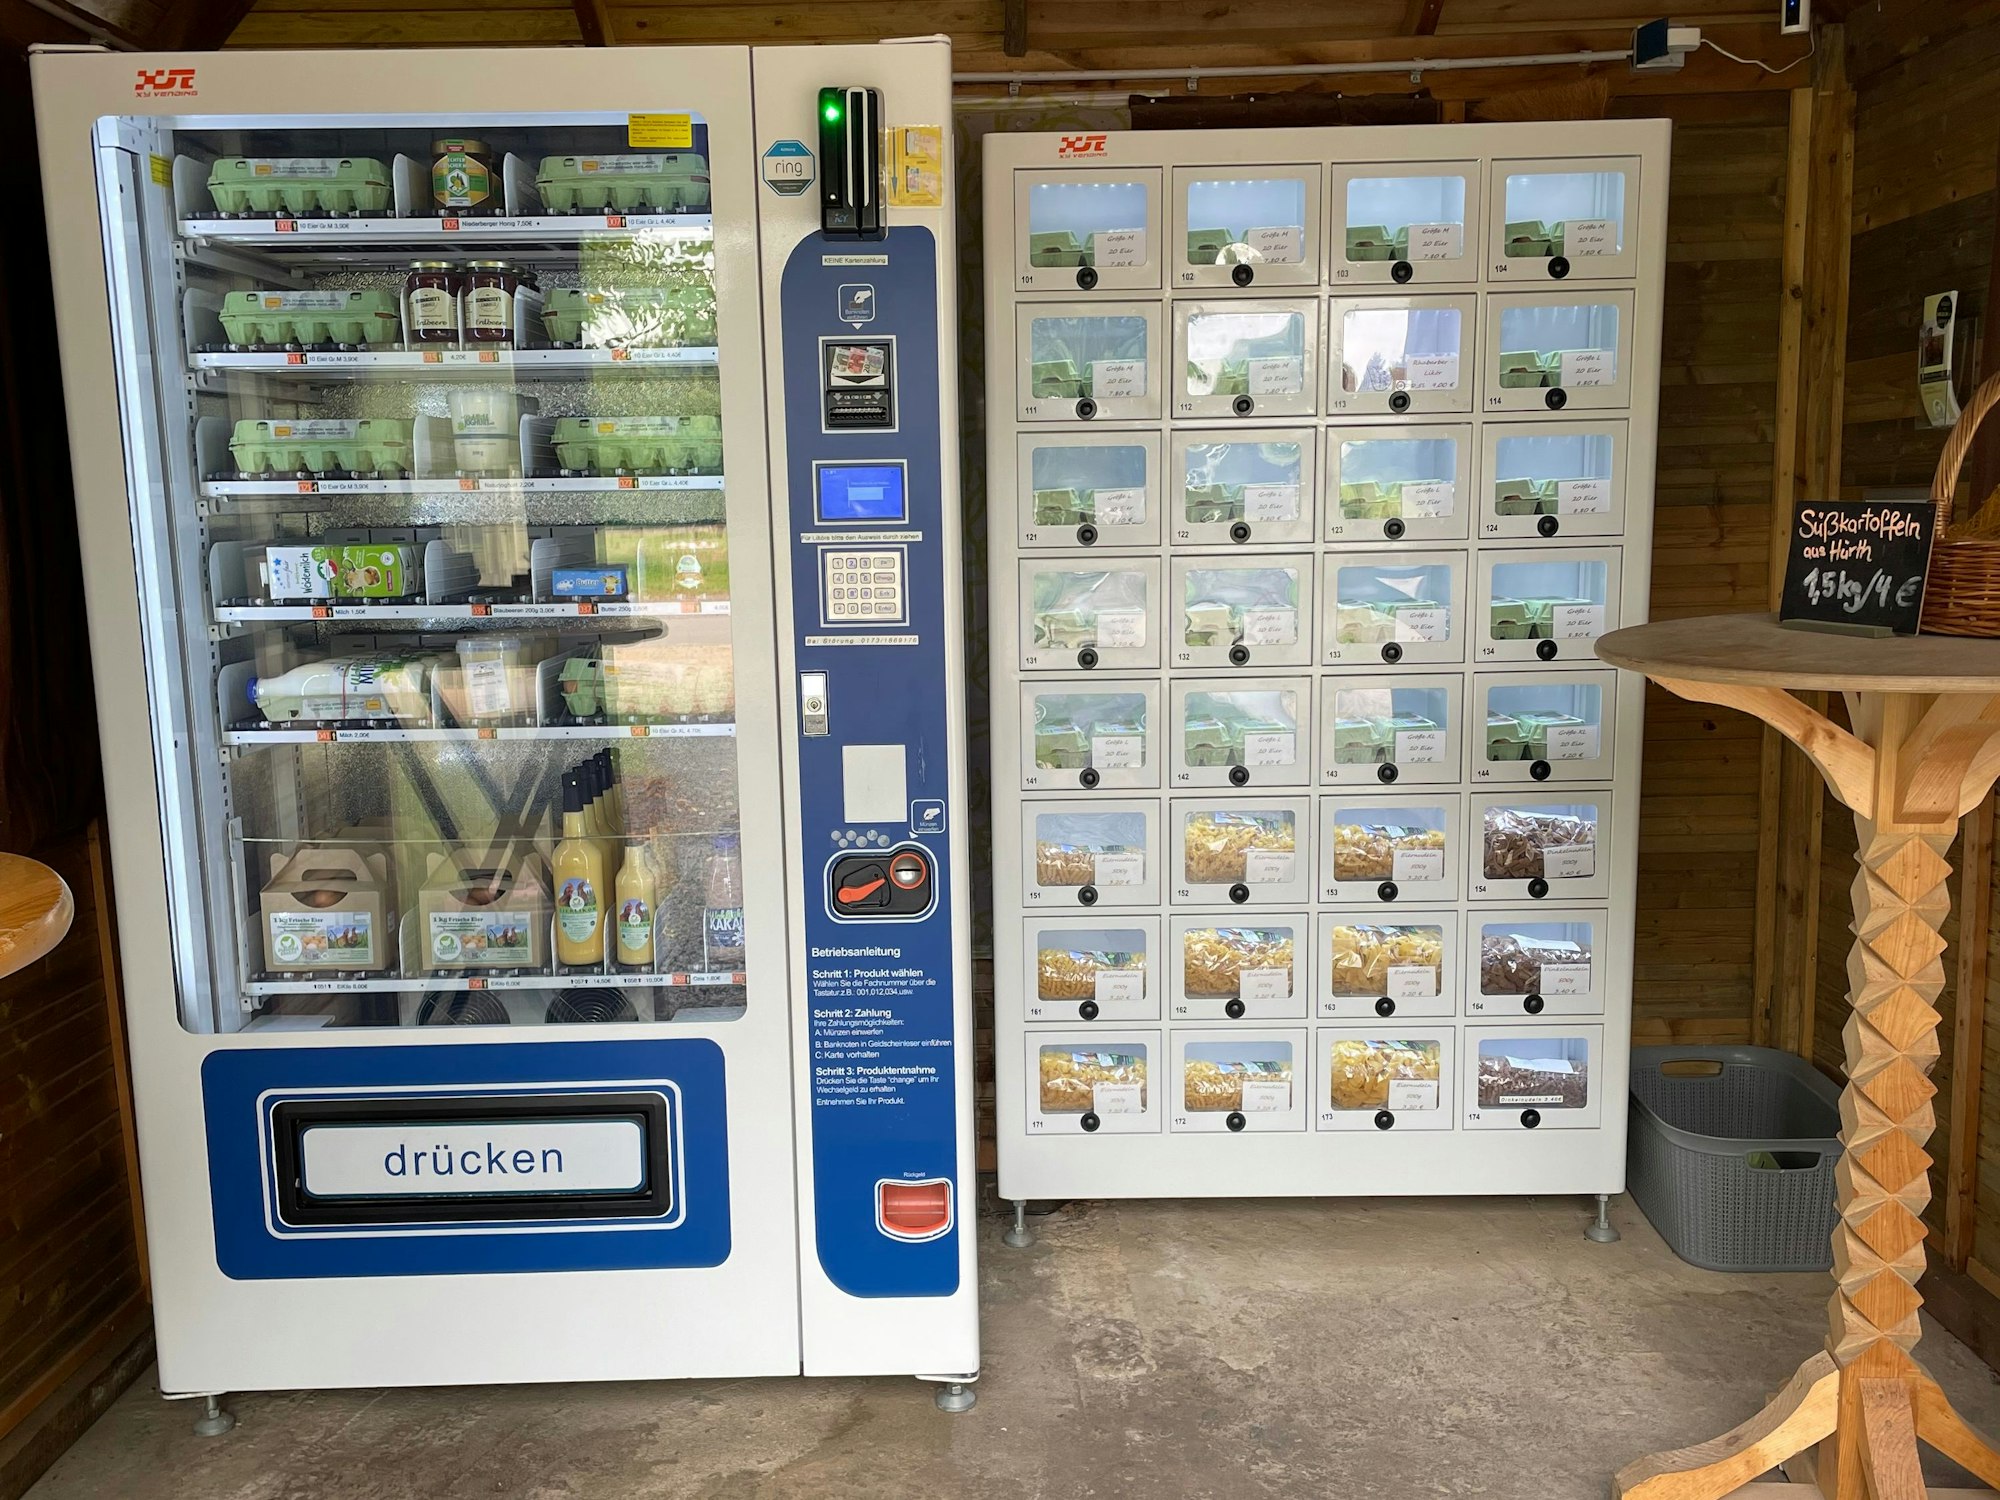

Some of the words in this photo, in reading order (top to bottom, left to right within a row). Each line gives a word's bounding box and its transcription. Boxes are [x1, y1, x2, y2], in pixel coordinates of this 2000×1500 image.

[776, 160, 803, 176] ring
[1022, 276, 1033, 284] 101
[1332, 526, 1343, 534] 123
[1799, 508, 1921, 542] Süßkartoffeln
[1178, 530, 1189, 538] 122
[1803, 543, 1826, 559] aus
[1830, 540, 1872, 562] Hürth
[1896, 576, 1921, 607] €
[812, 947, 900, 958] Betriebsanleitung
[813, 970, 842, 979] Schritt
[844, 970, 852, 978] 1:
[854, 969, 889, 977] Produkt
[891, 968, 923, 977] wählen
[814, 1009, 843, 1018] Schritt
[845, 1009, 853, 1017] 2:
[855, 1009, 891, 1018] Zahlung
[816, 1067, 845, 1075] Schritt
[846, 1067, 854, 1075] 3:
[857, 1066, 935, 1075] Produktentnahme
[817, 1086, 858, 1094] Wechselgeld
[817, 1098, 854, 1106] Entnehmen
[384, 1143, 563, 1176] drücken
